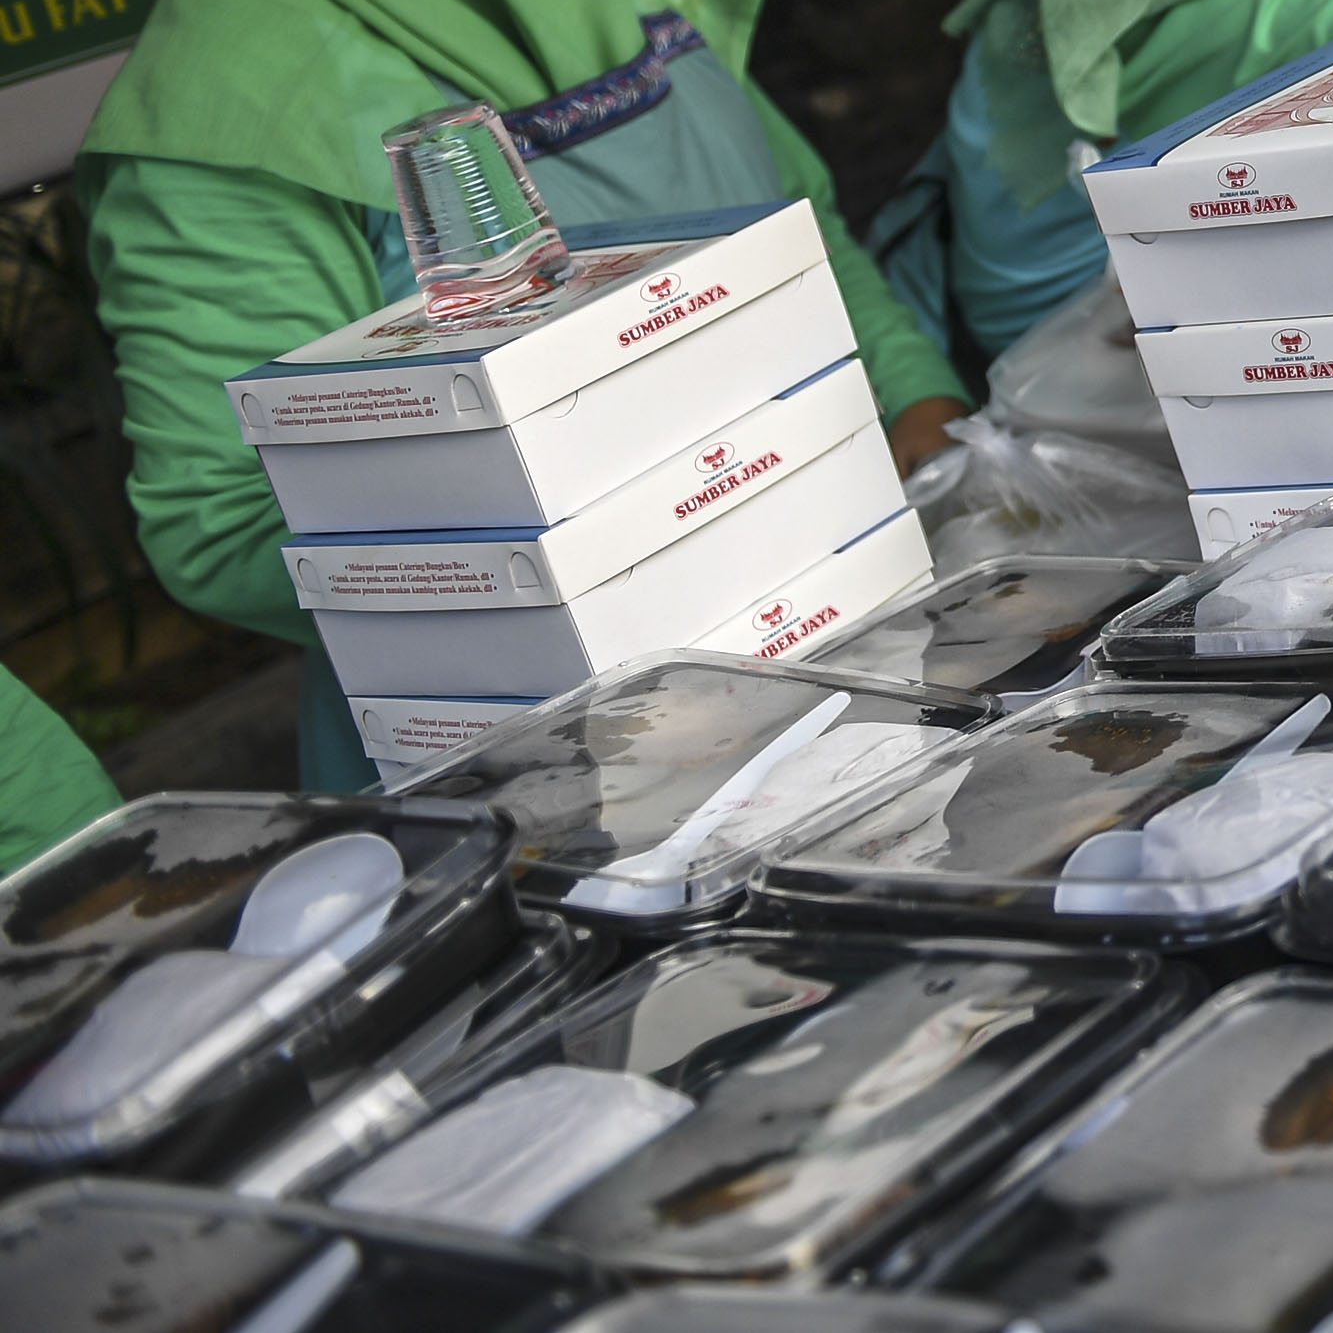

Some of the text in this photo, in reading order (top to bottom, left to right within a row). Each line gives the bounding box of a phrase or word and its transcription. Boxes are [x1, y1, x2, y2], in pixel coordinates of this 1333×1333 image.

[1189, 194, 1298, 220] SUMBER JAYA
[618, 283, 730, 348] SUMBER JAYA
[1244, 363, 1309, 383] SUMBER
[673, 450, 782, 520] SUMBER JAYA
[800, 605, 840, 638] JAYA
